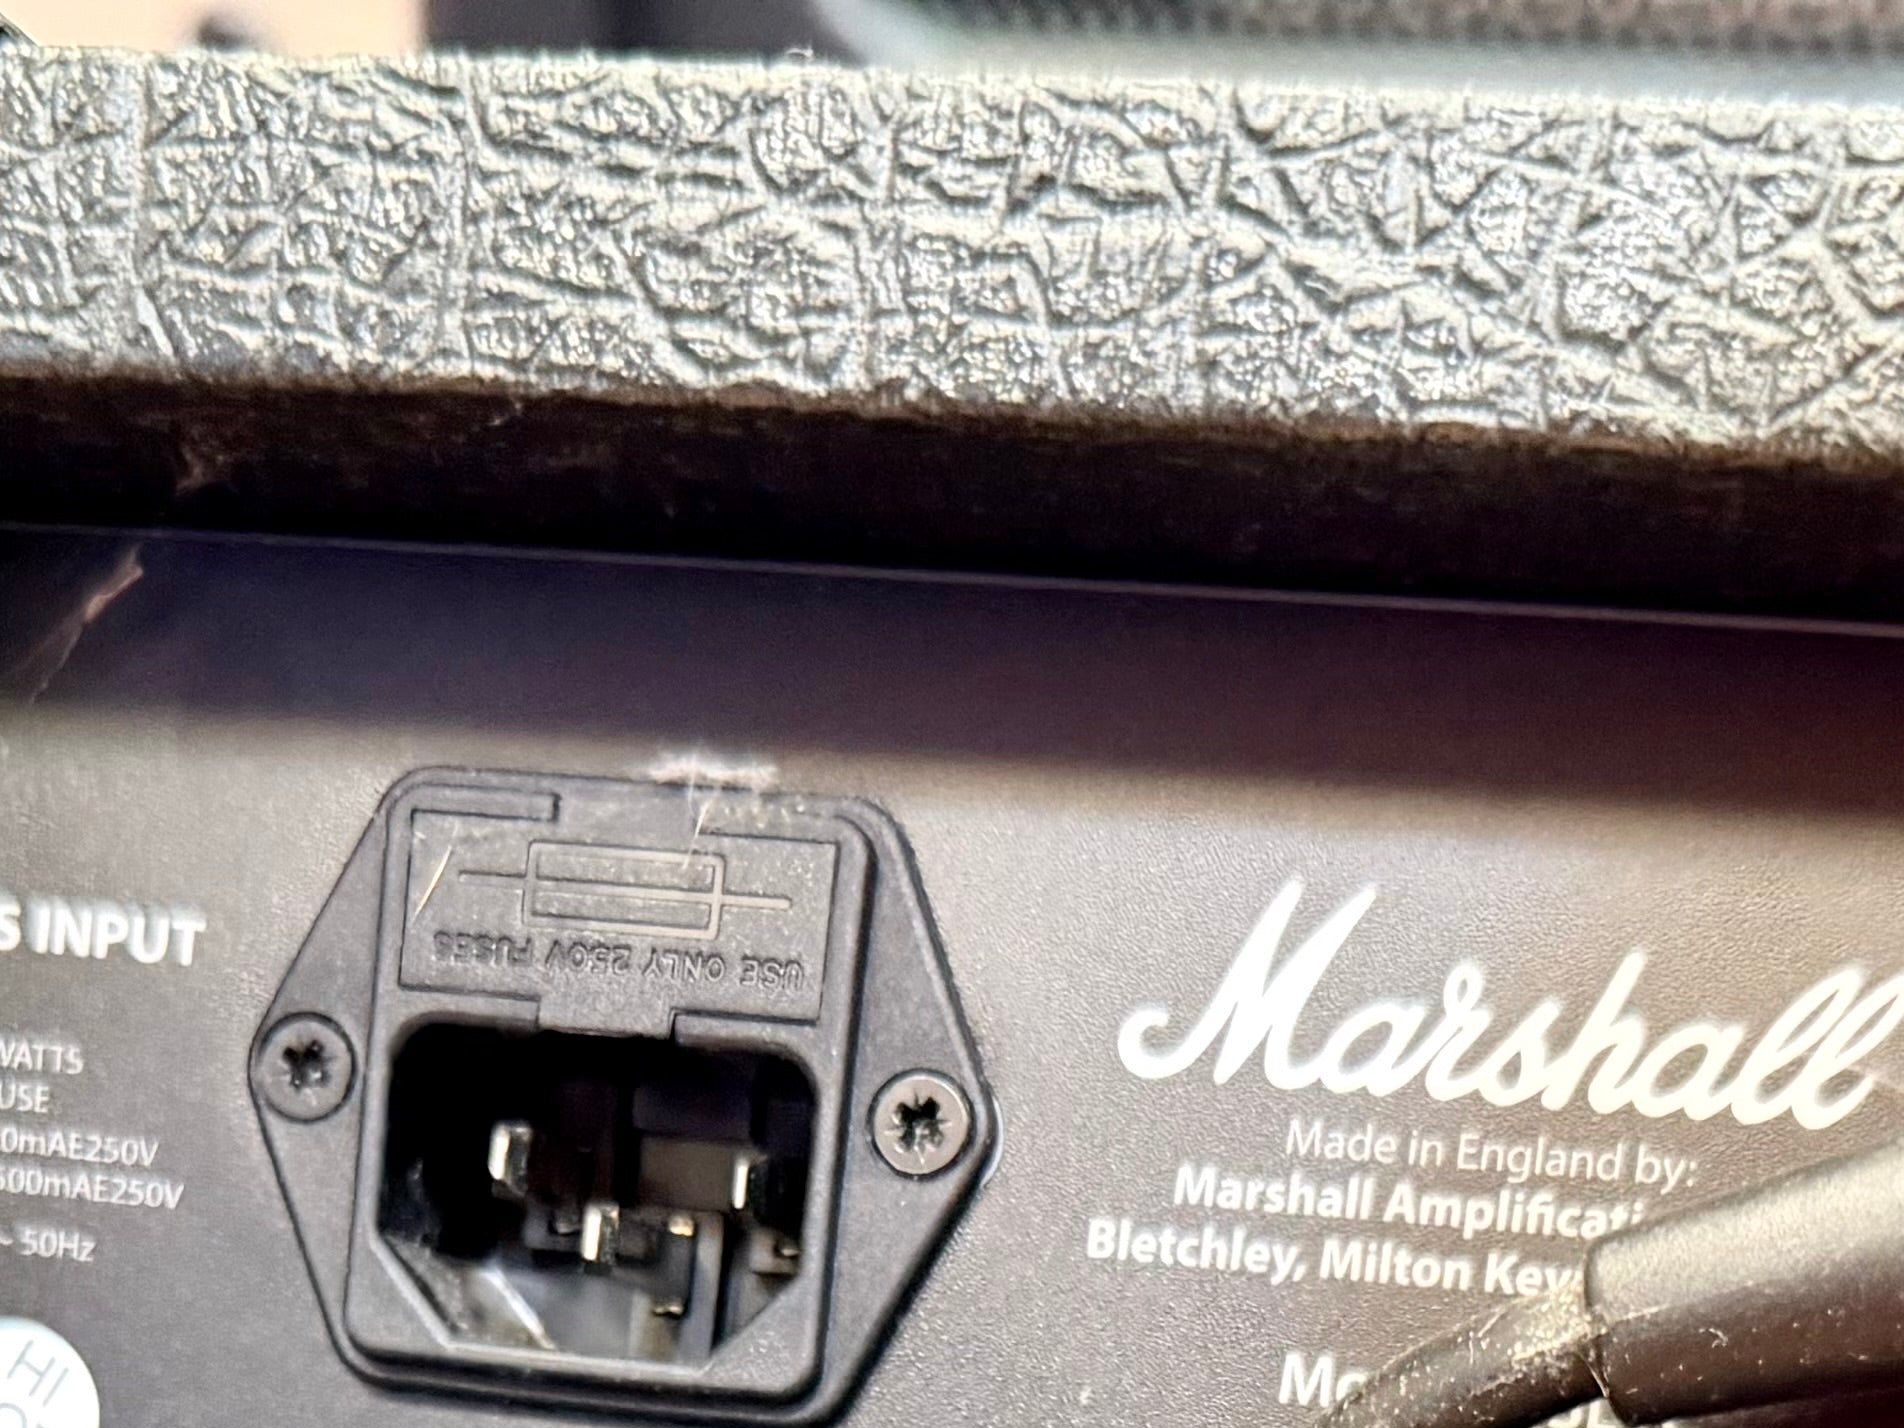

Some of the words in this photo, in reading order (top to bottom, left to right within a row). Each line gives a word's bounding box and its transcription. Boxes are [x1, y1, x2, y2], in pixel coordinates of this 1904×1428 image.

[28, 899, 206, 966] INPUT
[433, 931, 531, 967] FUSES
[545, 939, 631, 977] 250V
[642, 946, 727, 981] ONLY
[739, 954, 804, 990] USE
[1286, 1119, 1396, 1165] Made
[1409, 1131, 1444, 1167] in
[1458, 1134, 1622, 1185] England
[1636, 1145, 1696, 1195] by:
[1175, 1165, 1372, 1221] Marshall
[19, 1228, 96, 1262] 50Hz
[1086, 1217, 1303, 1286] Bletchley,
[1320, 1238, 1472, 1290] Milton
[6, 1339, 70, 1408] HI
